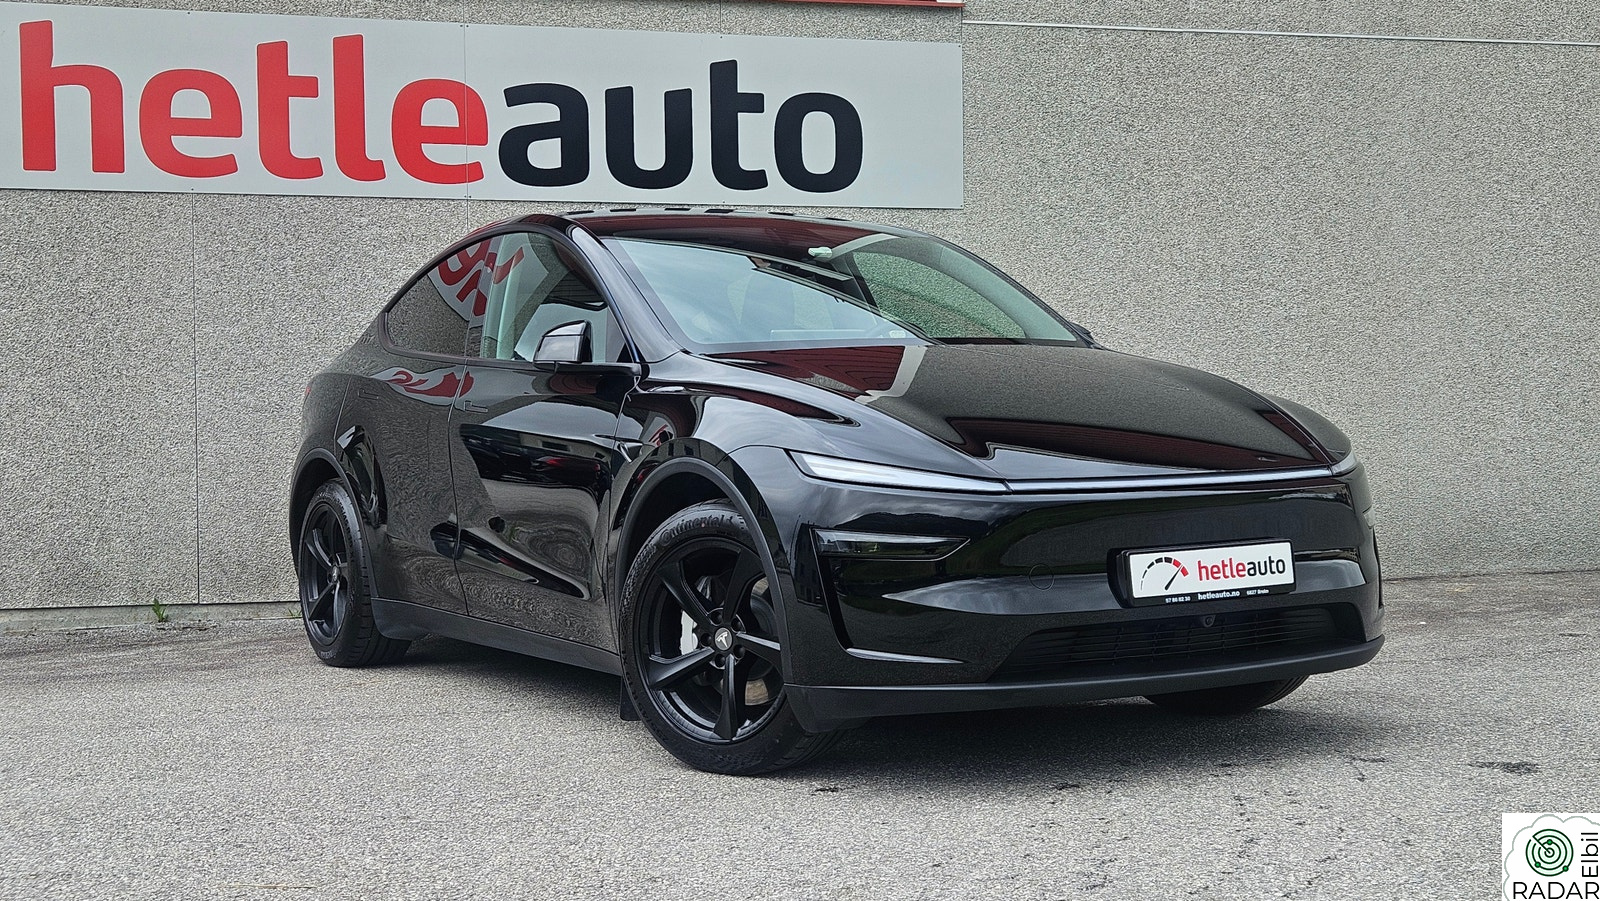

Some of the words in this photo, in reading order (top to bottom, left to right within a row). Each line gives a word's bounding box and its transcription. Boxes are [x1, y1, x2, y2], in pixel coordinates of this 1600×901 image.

[19, 20, 863, 193] hetleauto
[1197, 555, 1286, 581] hetleauto
[1198, 591, 1240, 600] hetleauto.no
